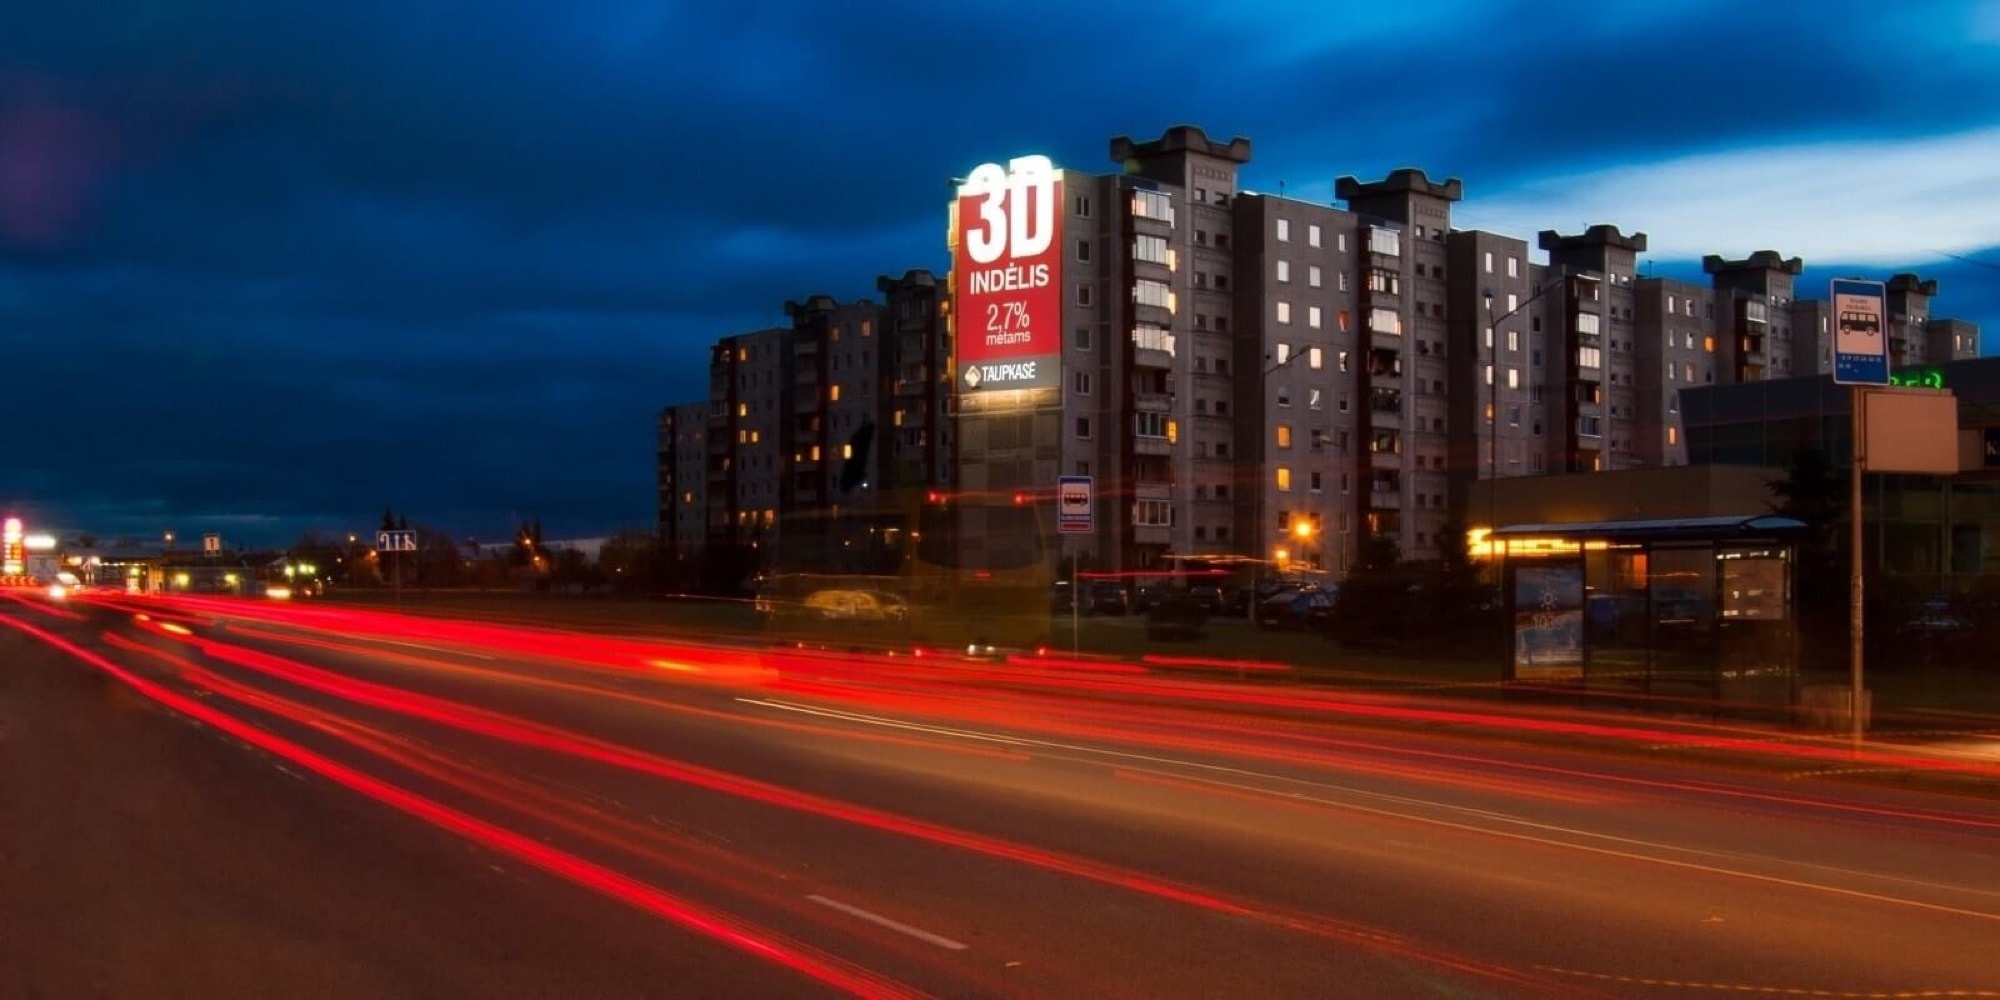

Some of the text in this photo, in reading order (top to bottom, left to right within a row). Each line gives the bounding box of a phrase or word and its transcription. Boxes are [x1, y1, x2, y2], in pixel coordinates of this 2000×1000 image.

[967, 155, 1053, 263] 3D
[970, 262, 1050, 295] INDĖLIS
[986, 300, 1030, 333] 2,7%
